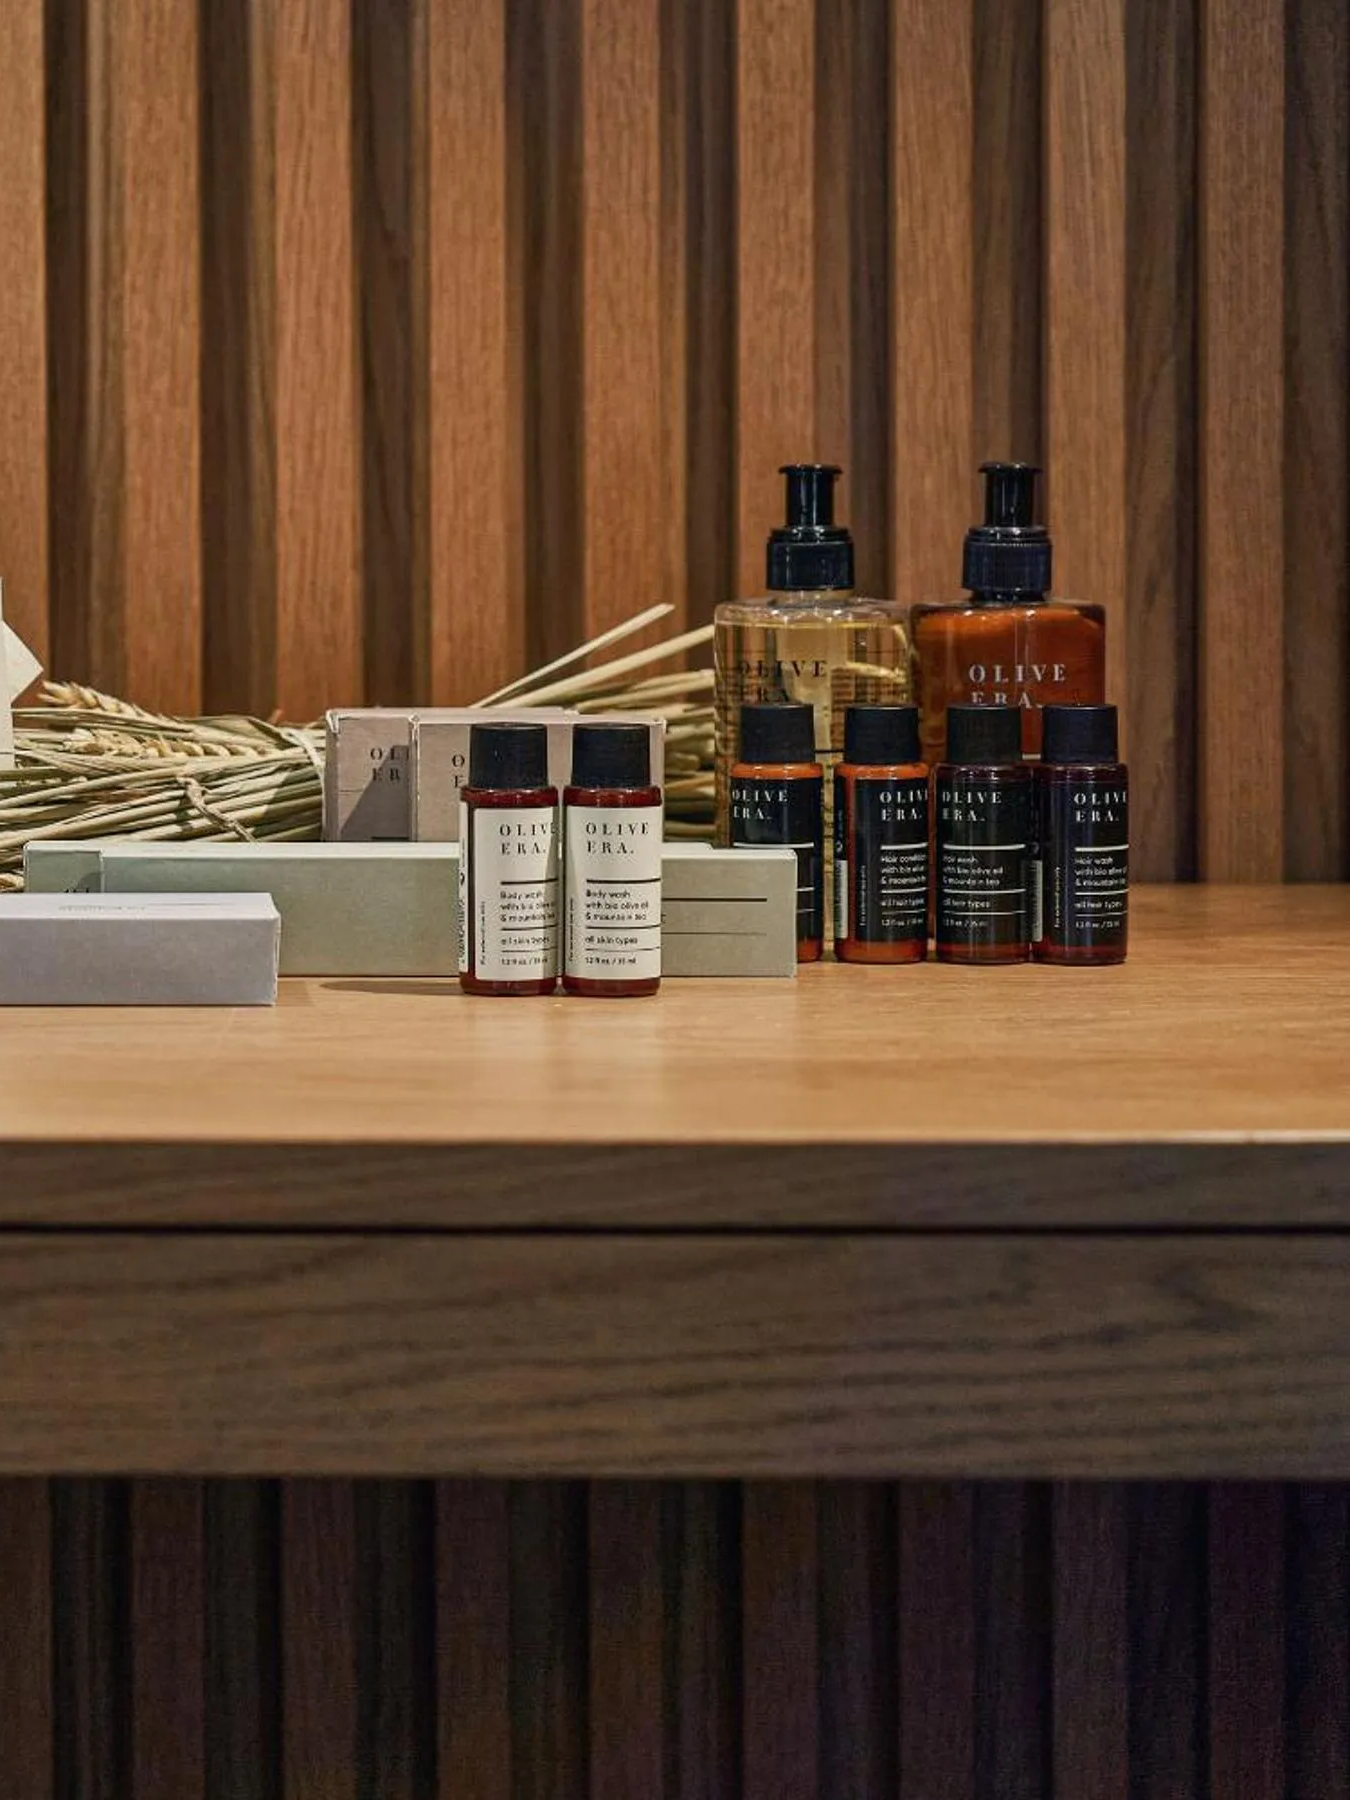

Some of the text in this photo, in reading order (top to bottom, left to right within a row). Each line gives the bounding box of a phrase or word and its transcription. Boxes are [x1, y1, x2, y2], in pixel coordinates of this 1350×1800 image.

[739, 660, 827, 677] OLIVE
[970, 664, 1066, 682] OLIVE
[972, 692, 1043, 708] ERA.
[732, 789, 787, 802] OLIVE
[942, 791, 1002, 804] OLIVE
[881, 808, 922, 821] ERA.
[1076, 810, 1119, 822] ERA.
[586, 822, 649, 836] OLIVE
[501, 842, 546, 855] ERA.
[587, 840, 634, 854] ERA.
[586, 889, 631, 900] Body wash
[586, 900, 602, 909] with
[621, 900, 639, 910] olive
[597, 935, 612, 944] skin
[615, 936, 638, 945] types
